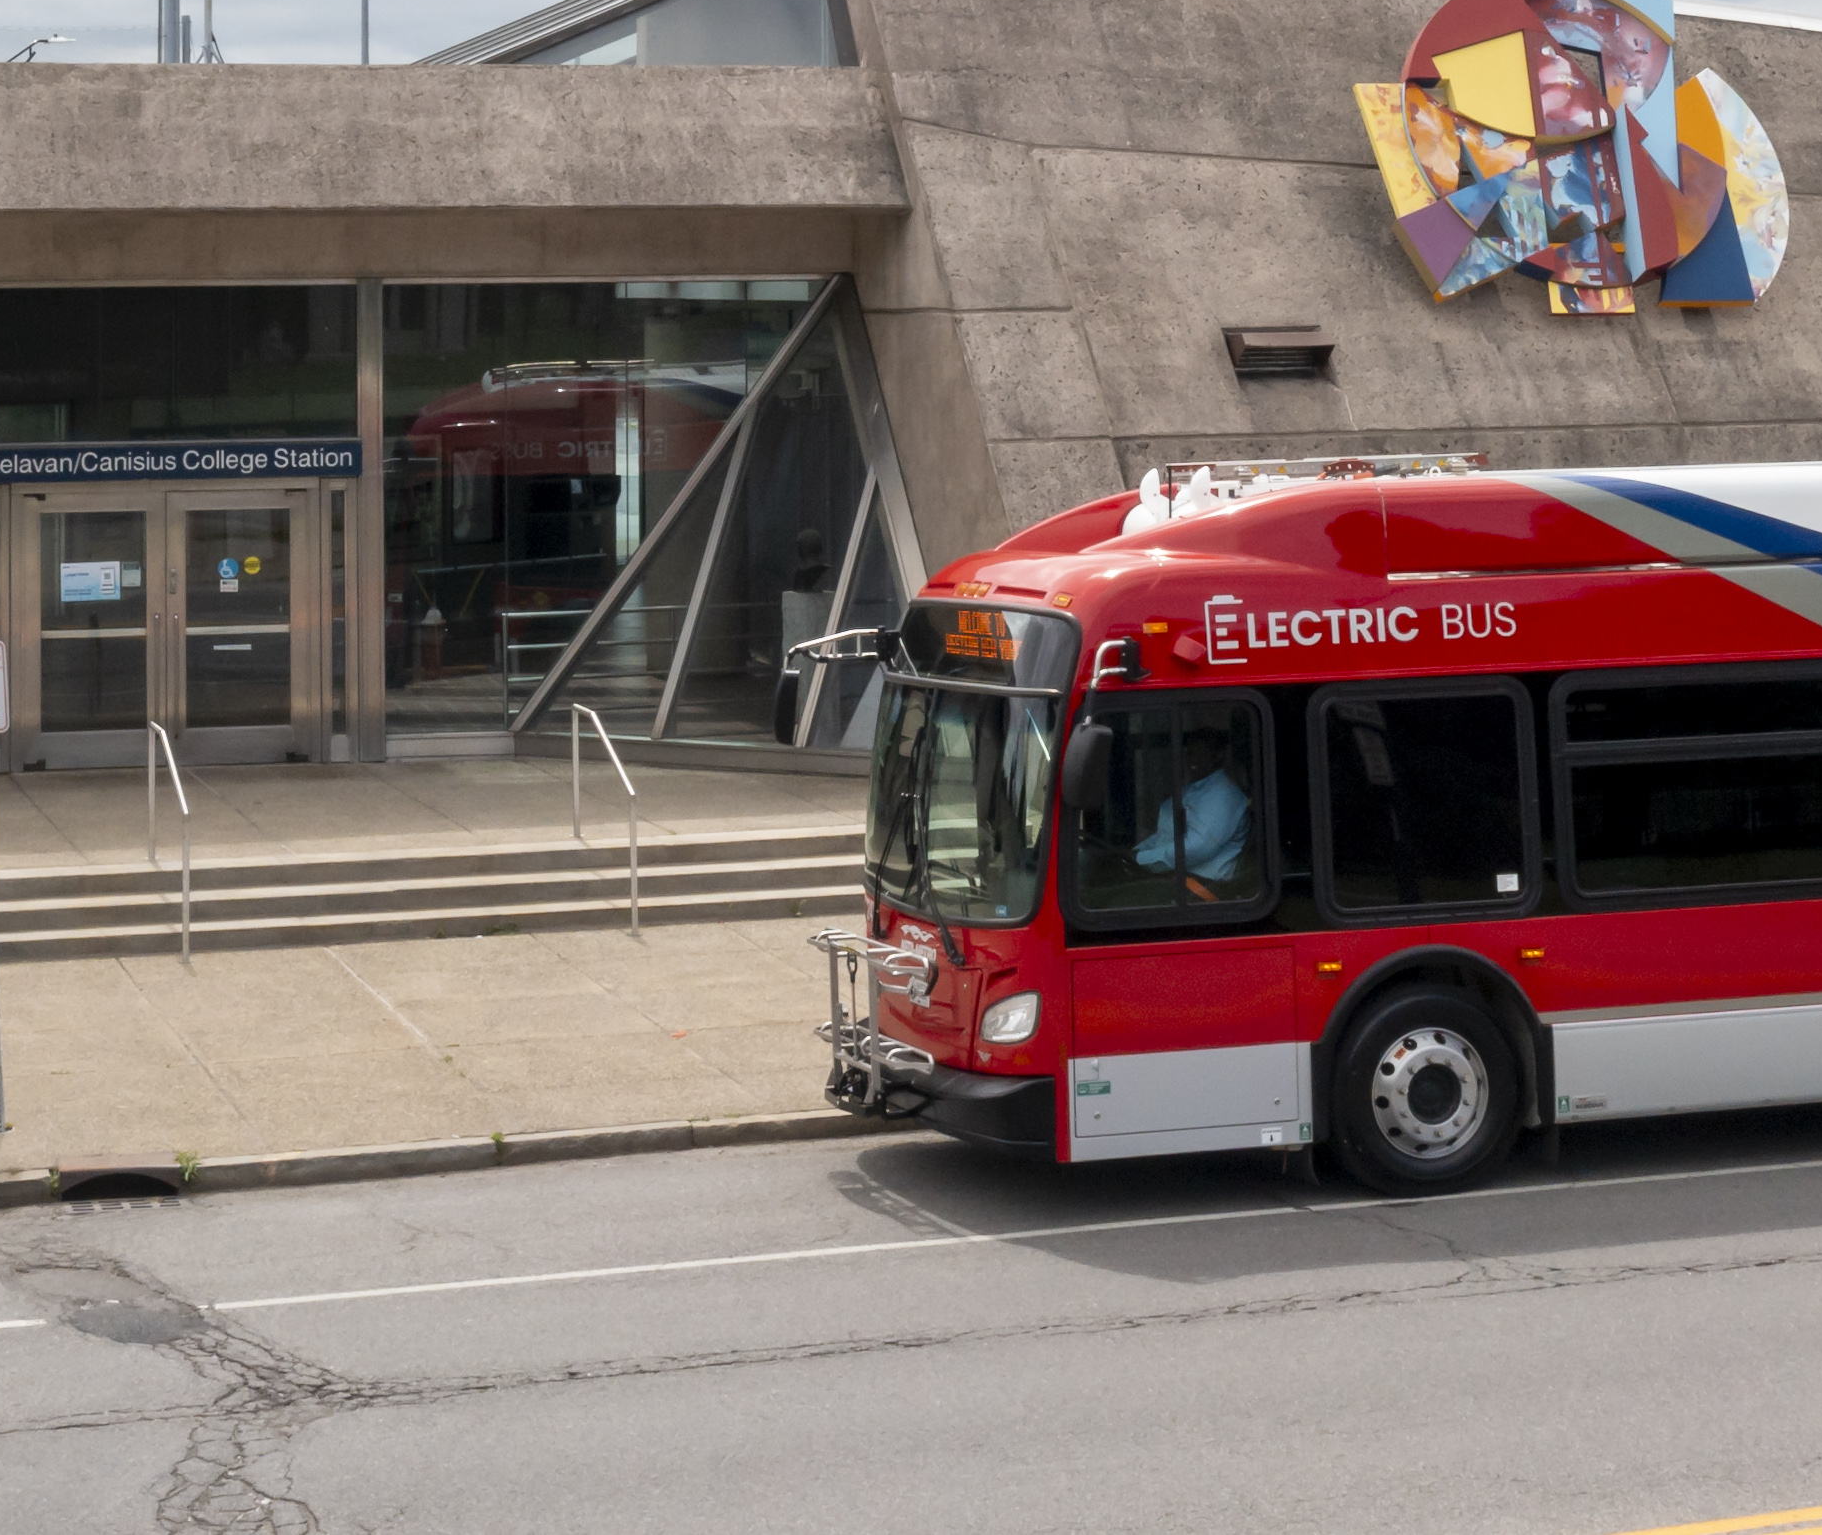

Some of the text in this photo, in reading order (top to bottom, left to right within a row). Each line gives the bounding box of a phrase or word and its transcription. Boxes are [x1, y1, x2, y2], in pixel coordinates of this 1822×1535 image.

[182, 449, 269, 473] College
[274, 448, 353, 468] Station
[1204, 595, 1517, 665] ELECTRIC BUS
